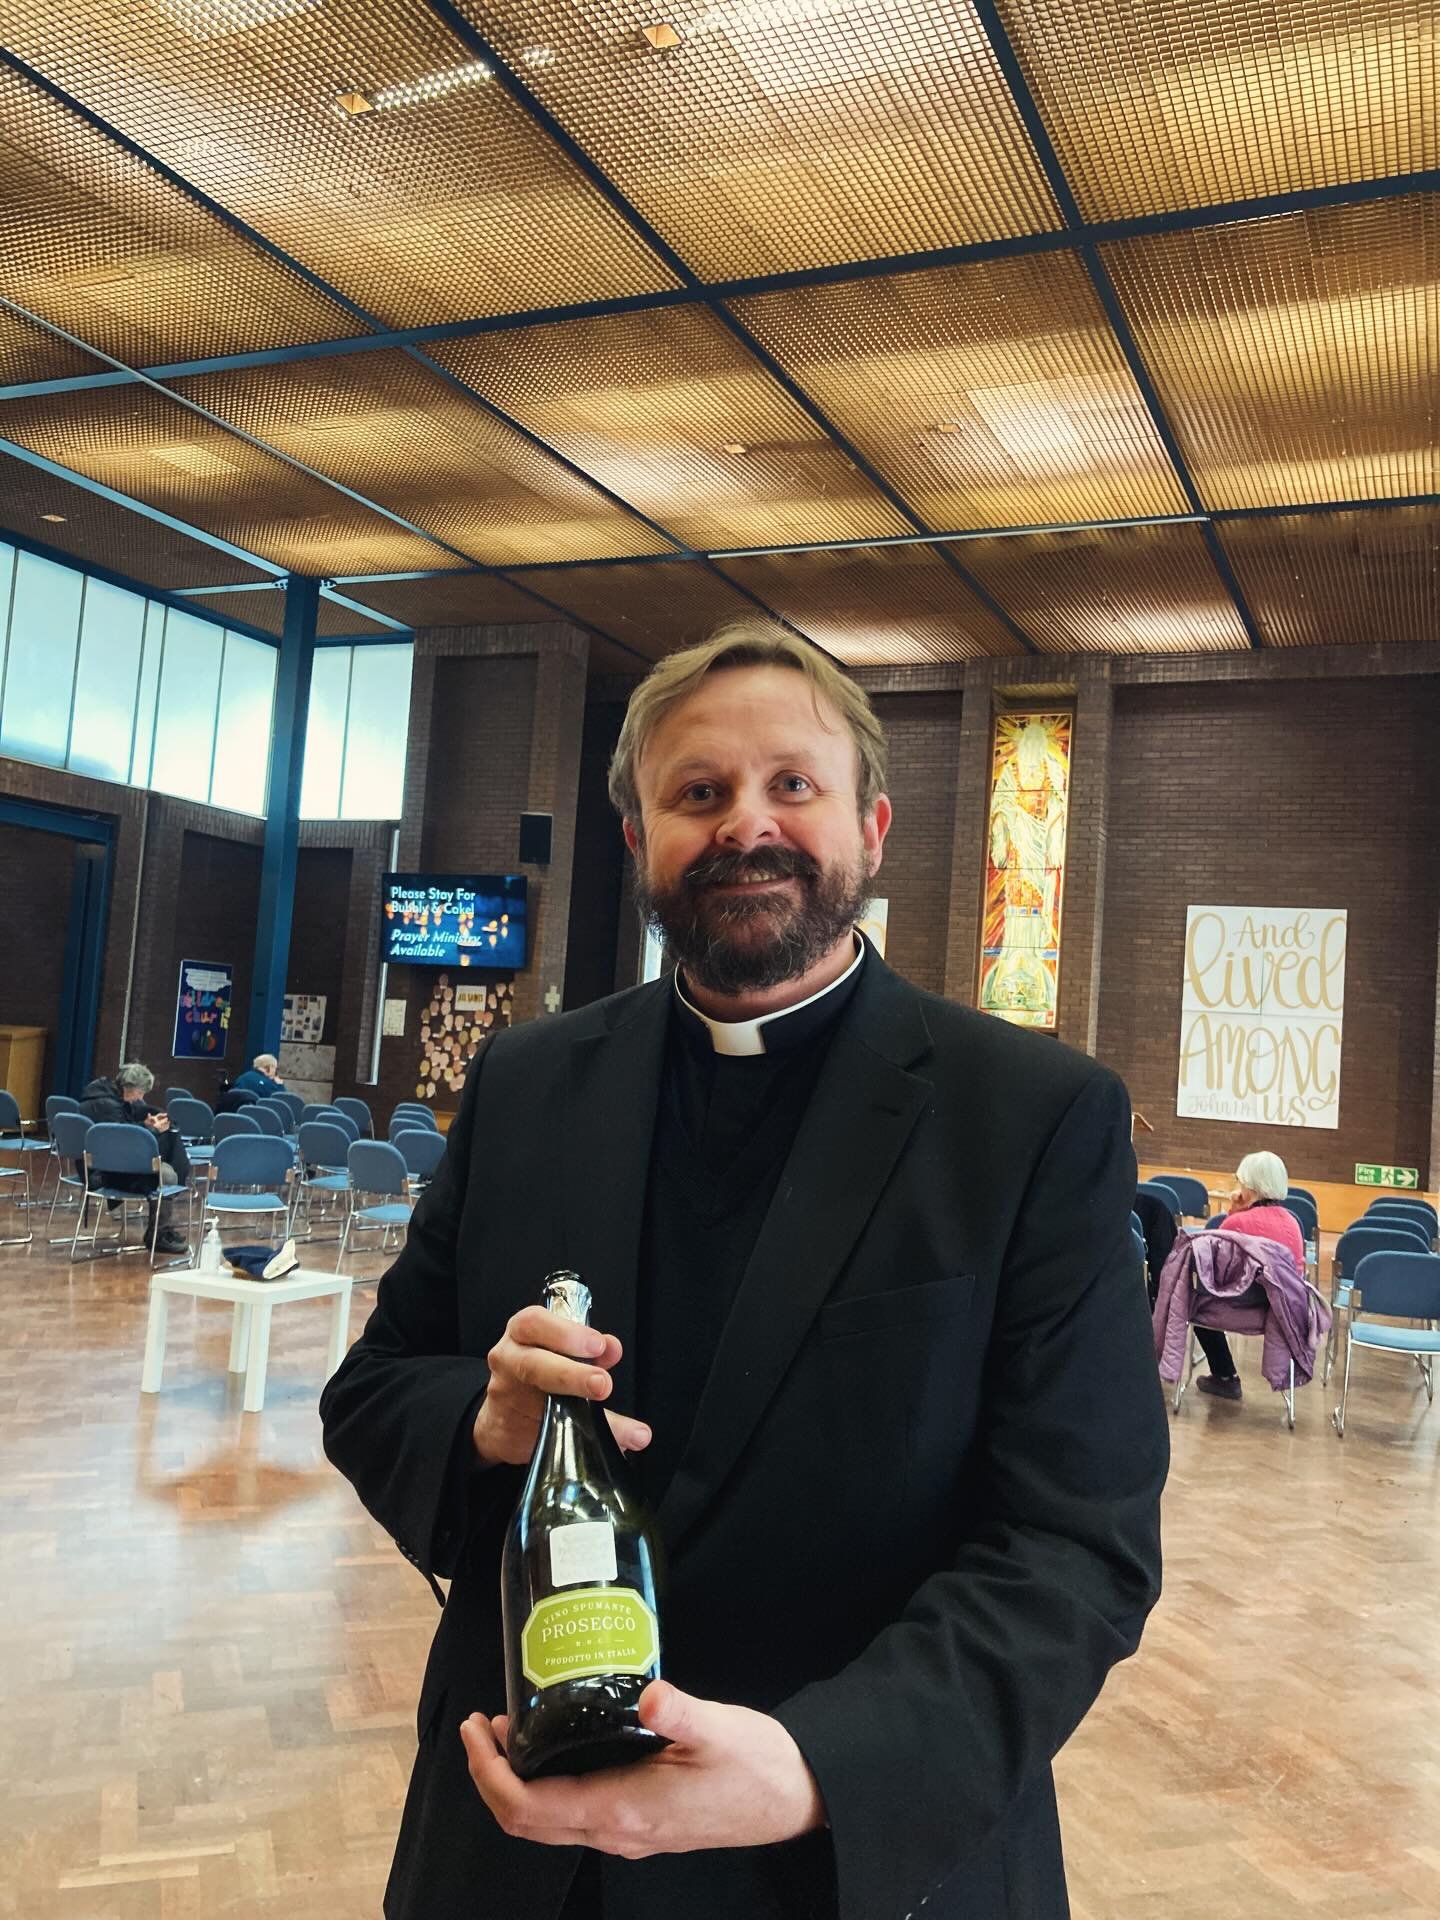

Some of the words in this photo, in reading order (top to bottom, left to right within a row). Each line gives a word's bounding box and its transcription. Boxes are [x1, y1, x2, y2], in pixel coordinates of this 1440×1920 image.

[390, 886, 426, 899] Please
[429, 887, 454, 902] Stay
[456, 888, 476, 901] For
[391, 901, 429, 916] Bubbly
[431, 902, 440, 914] &
[391, 929, 430, 944] Prayer
[433, 931, 481, 945] Ministry
[1233, 911, 1315, 949] And
[390, 945, 446, 958] Available
[1184, 912, 1346, 1012] lived
[544, 1609, 569, 1625] VINO
[572, 1602, 632, 1616] SPUMANTE
[541, 1616, 637, 1643] PROSECCO
[545, 1652, 592, 1666] PRODOTTO
[594, 1651, 605, 1660] IN
[607, 1646, 637, 1658] ITALIA
